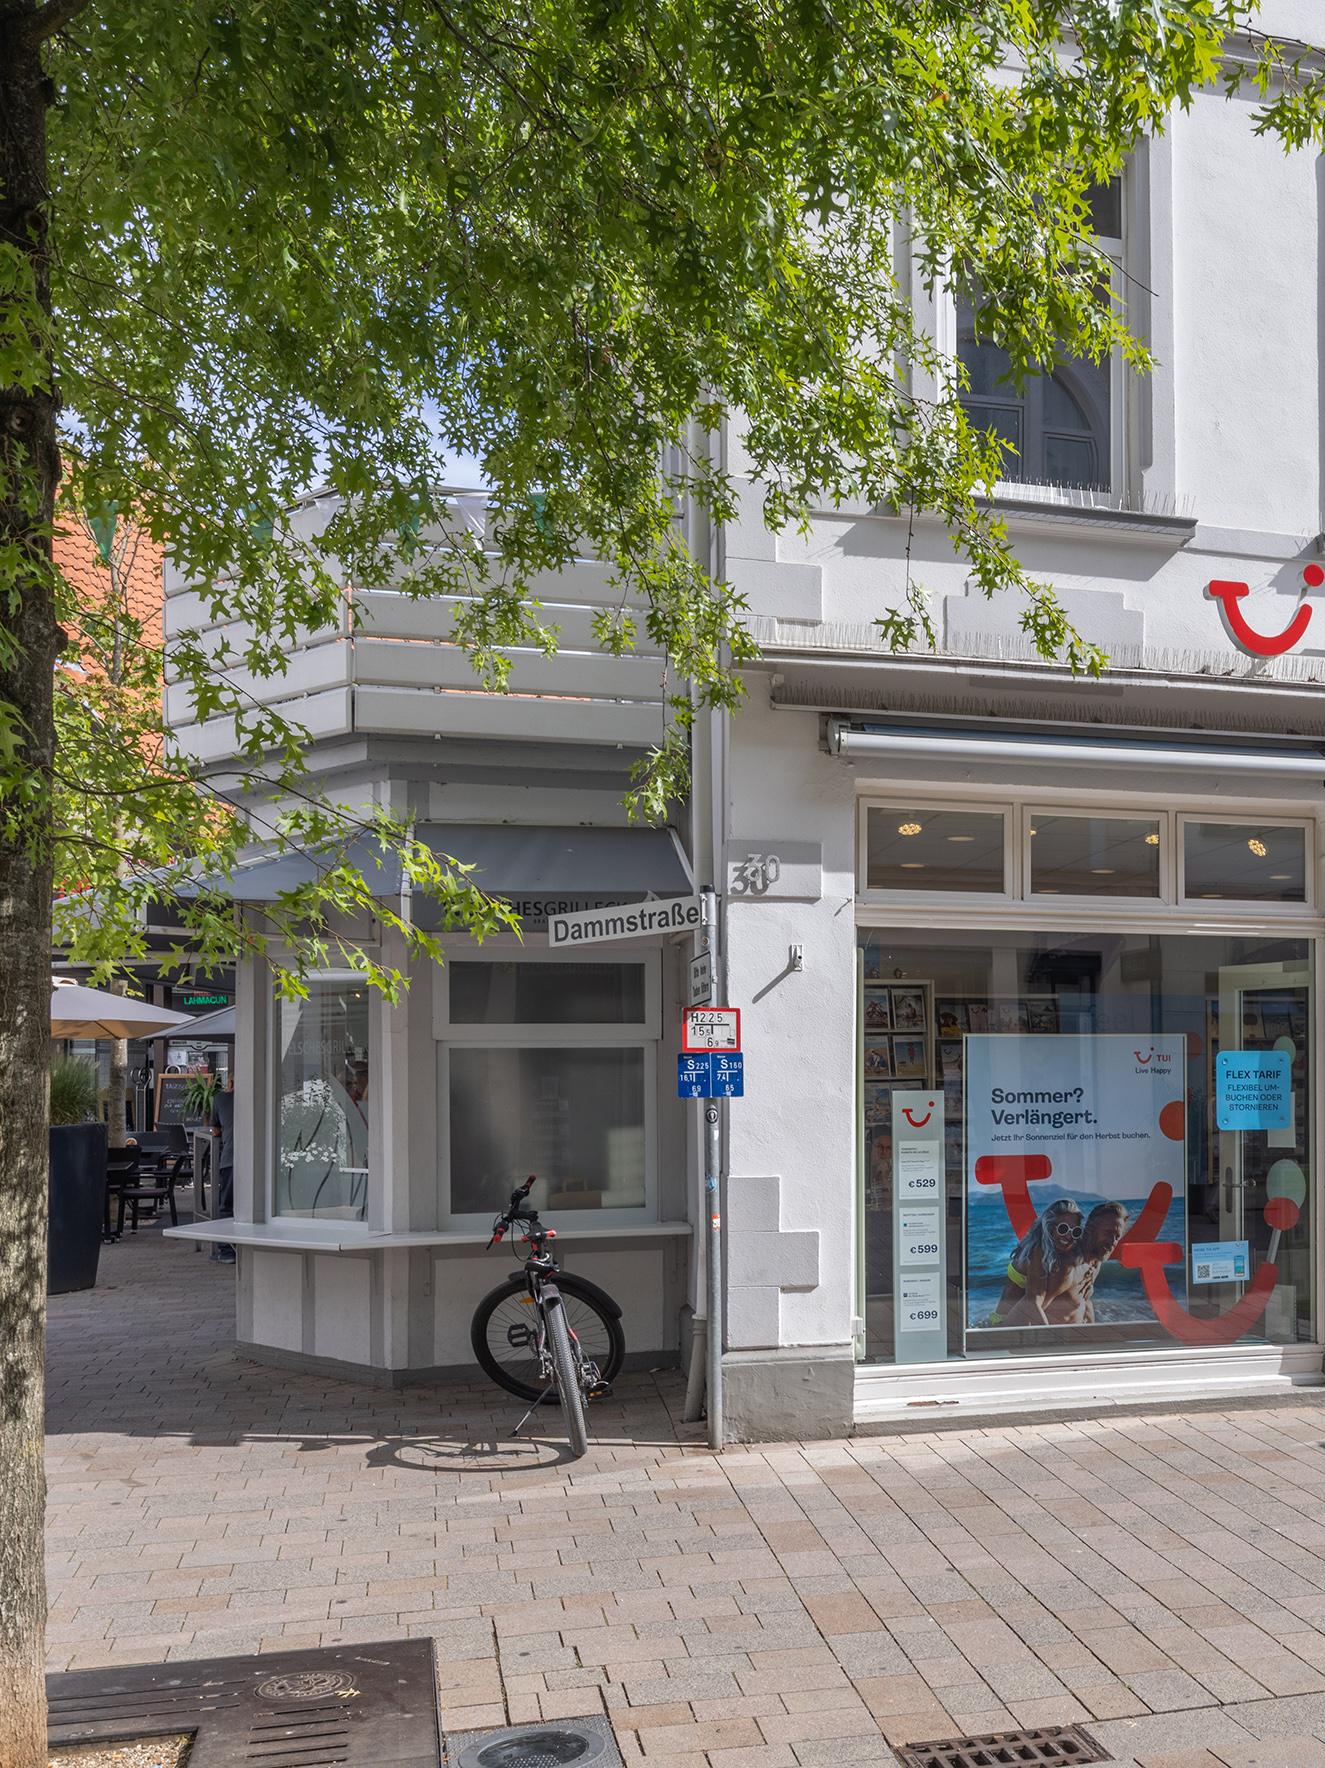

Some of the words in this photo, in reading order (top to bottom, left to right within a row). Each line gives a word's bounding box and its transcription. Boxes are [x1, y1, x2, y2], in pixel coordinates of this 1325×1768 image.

[553, 902, 700, 943] Dammstraße
[1156, 1054, 1172, 1062] TUI
[1150, 1067, 1172, 1075] Happy
[1226, 1070, 1251, 1079] FLEX
[1253, 1070, 1282, 1079] TARIF
[1227, 1083, 1263, 1092] FLEXIBEL
[1264, 1083, 1280, 1091] UM-
[991, 1087, 1084, 1104] Sommer?
[1260, 1093, 1282, 1101] ODER
[1229, 1103, 1279, 1111] STORNIEREN
[990, 1109, 1098, 1129] Verlängert.
[991, 1134, 1012, 1142] Jetzt
[1013, 1133, 1024, 1141] Ihr
[1067, 1132, 1078, 1140] für
[1079, 1132, 1094, 1140] den
[1122, 1131, 1151, 1139] buchen.
